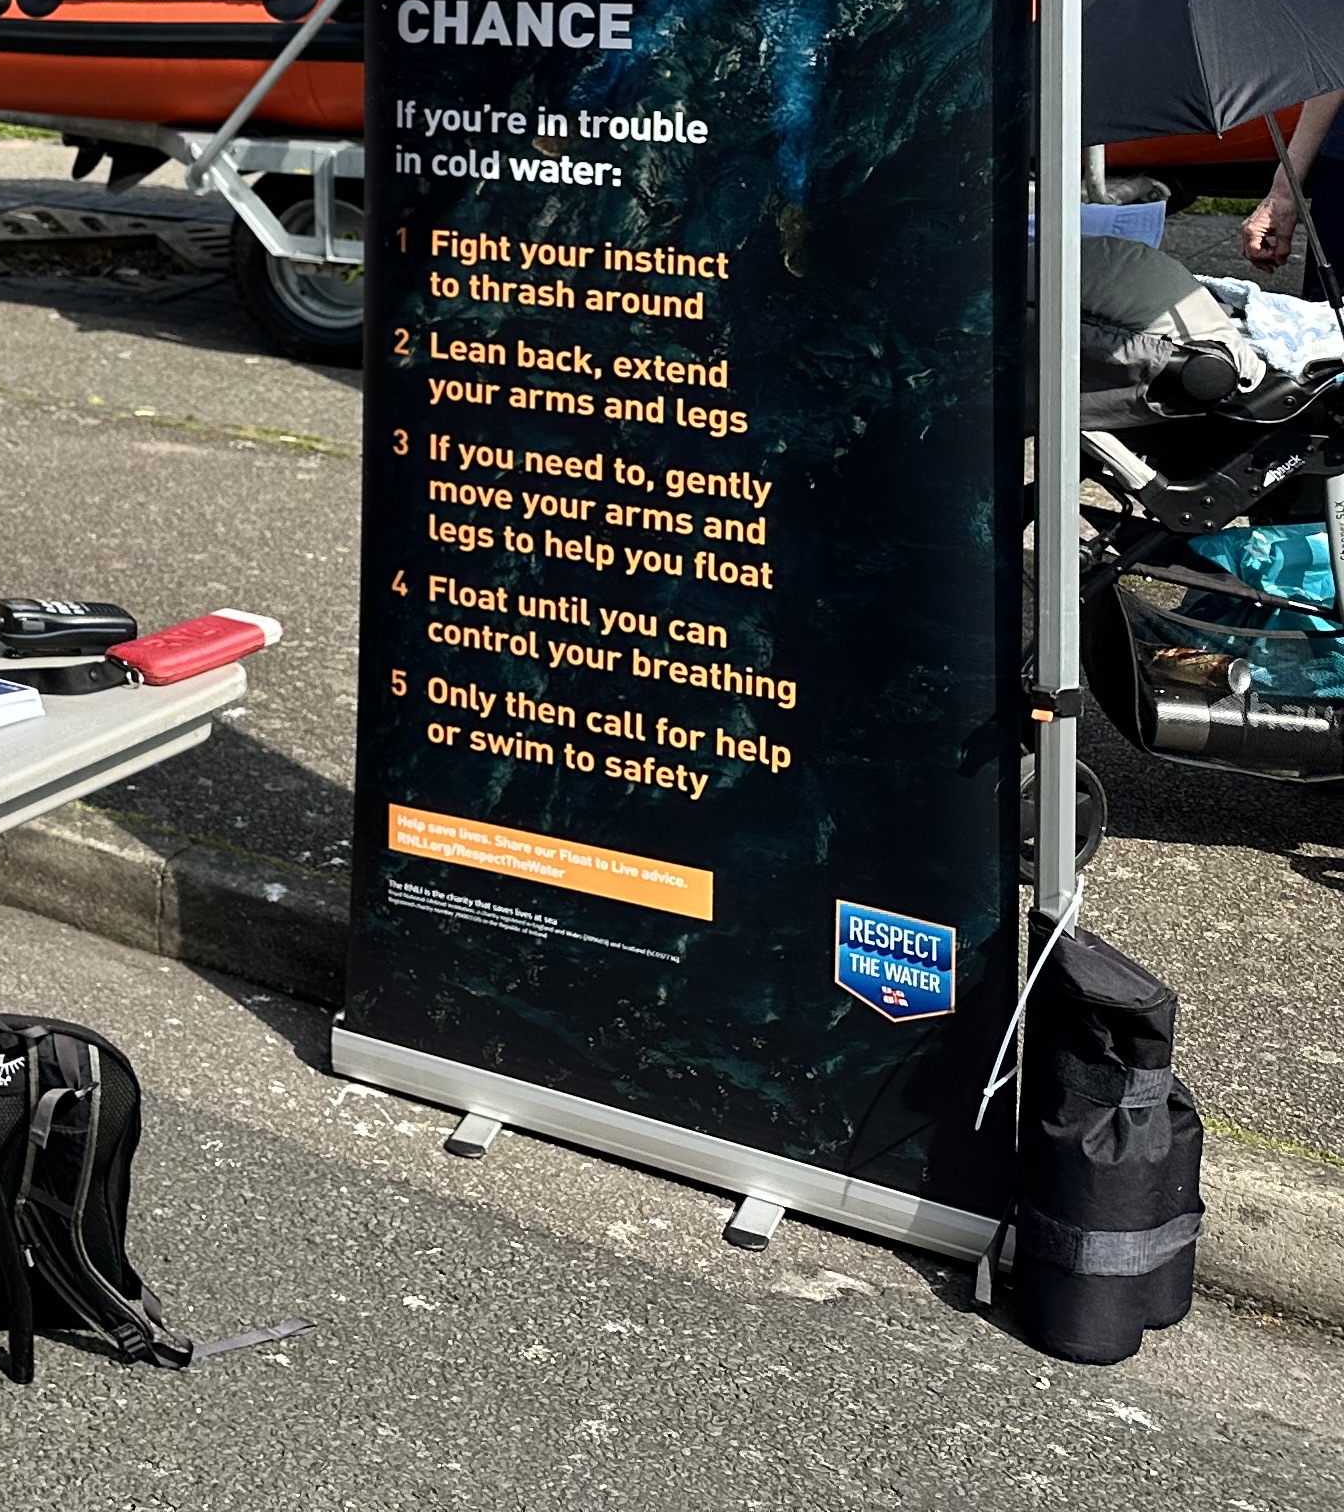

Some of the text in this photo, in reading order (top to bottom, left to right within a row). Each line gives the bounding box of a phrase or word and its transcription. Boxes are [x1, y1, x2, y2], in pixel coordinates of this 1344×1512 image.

[397, 0, 634, 51] CHANCE
[396, 99, 709, 145] If you're in trouble
[395, 146, 623, 188] in cold water:
[397, 227, 729, 280] 1 Fight your instinct
[430, 271, 703, 321] to thrash around
[394, 329, 728, 389] 2 Lean back, extend
[429, 376, 749, 438] your arms and legs
[393, 429, 772, 509] 3 If you need to, gently
[429, 477, 767, 546] move your arms and
[429, 514, 773, 590] legs to help you float
[391, 570, 727, 649] 4 Float until you can
[427, 621, 797, 709] control your breathing
[391, 670, 792, 774] 5 Only then call for help
[427, 721, 709, 801] or swim to safety
[397, 814, 688, 888] Help save lives. Share our Float to Live advice.
[849, 915, 941, 962] RESPECT
[849, 953, 941, 994] THE WATER
